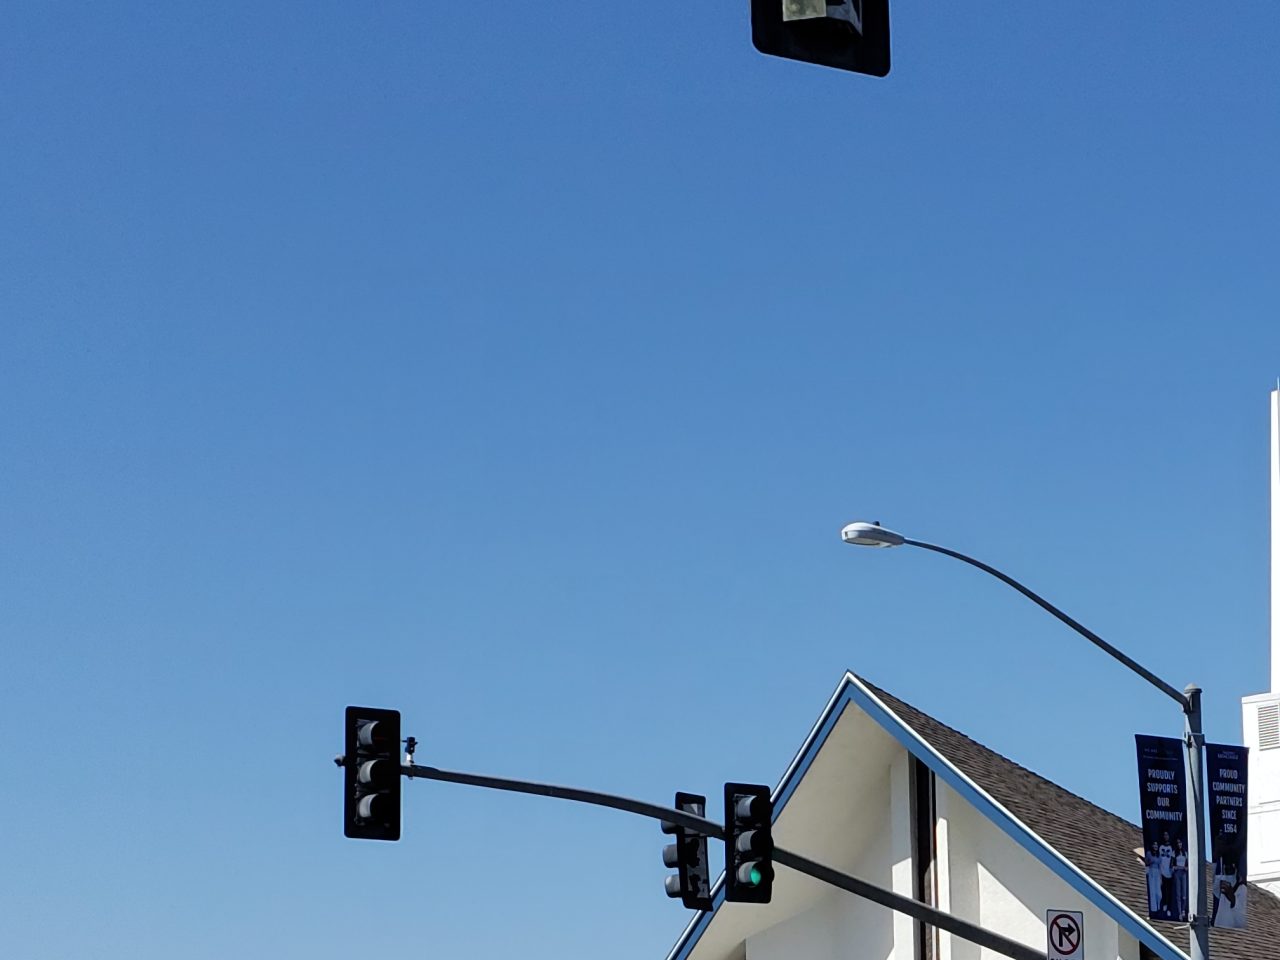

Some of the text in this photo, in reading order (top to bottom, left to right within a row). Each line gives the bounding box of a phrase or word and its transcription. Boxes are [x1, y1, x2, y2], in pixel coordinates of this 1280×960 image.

[1148, 769, 1175, 780] PROUDLY
[1219, 768, 1238, 779] PROUD
[1146, 782, 1178, 794] SUPPORTS
[1212, 781, 1245, 794] COMMUNITY
[1157, 797, 1170, 807] OUR
[1216, 796, 1242, 807] PARTNERS
[1146, 809, 1183, 821] COMMUNITY
[1222, 810, 1237, 820] SINCE
